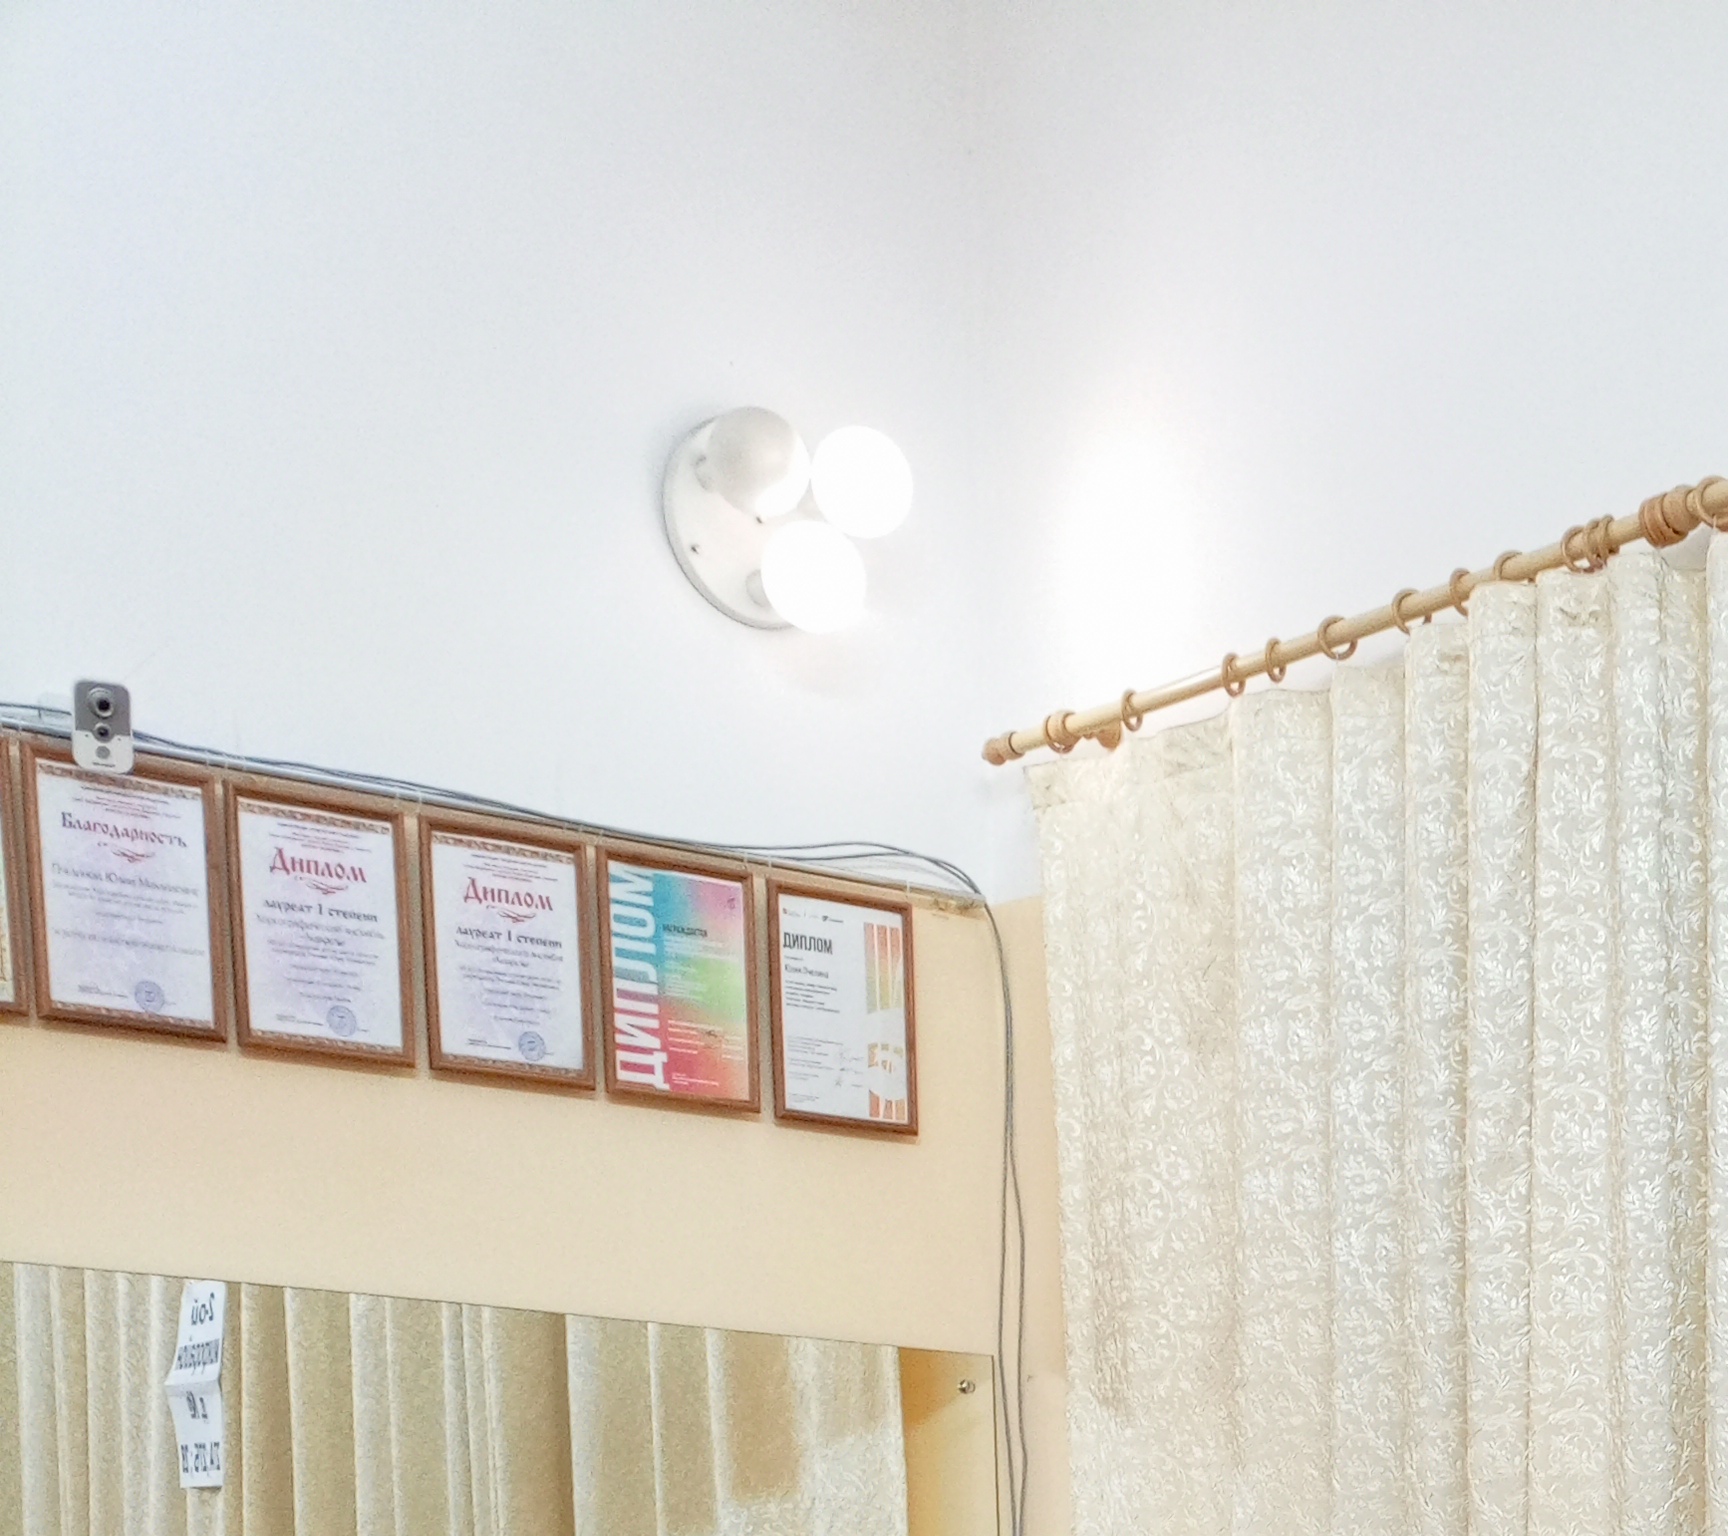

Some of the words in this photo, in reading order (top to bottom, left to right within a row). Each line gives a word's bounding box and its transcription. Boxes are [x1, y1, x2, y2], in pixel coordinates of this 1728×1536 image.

[60, 811, 188, 848] Благодарность
[269, 846, 368, 884] Диплом
[463, 876, 554, 912] Диплом
[783, 931, 833, 955] ДИПЛОМ
[608, 860, 671, 1092] ДИПЛОМ
